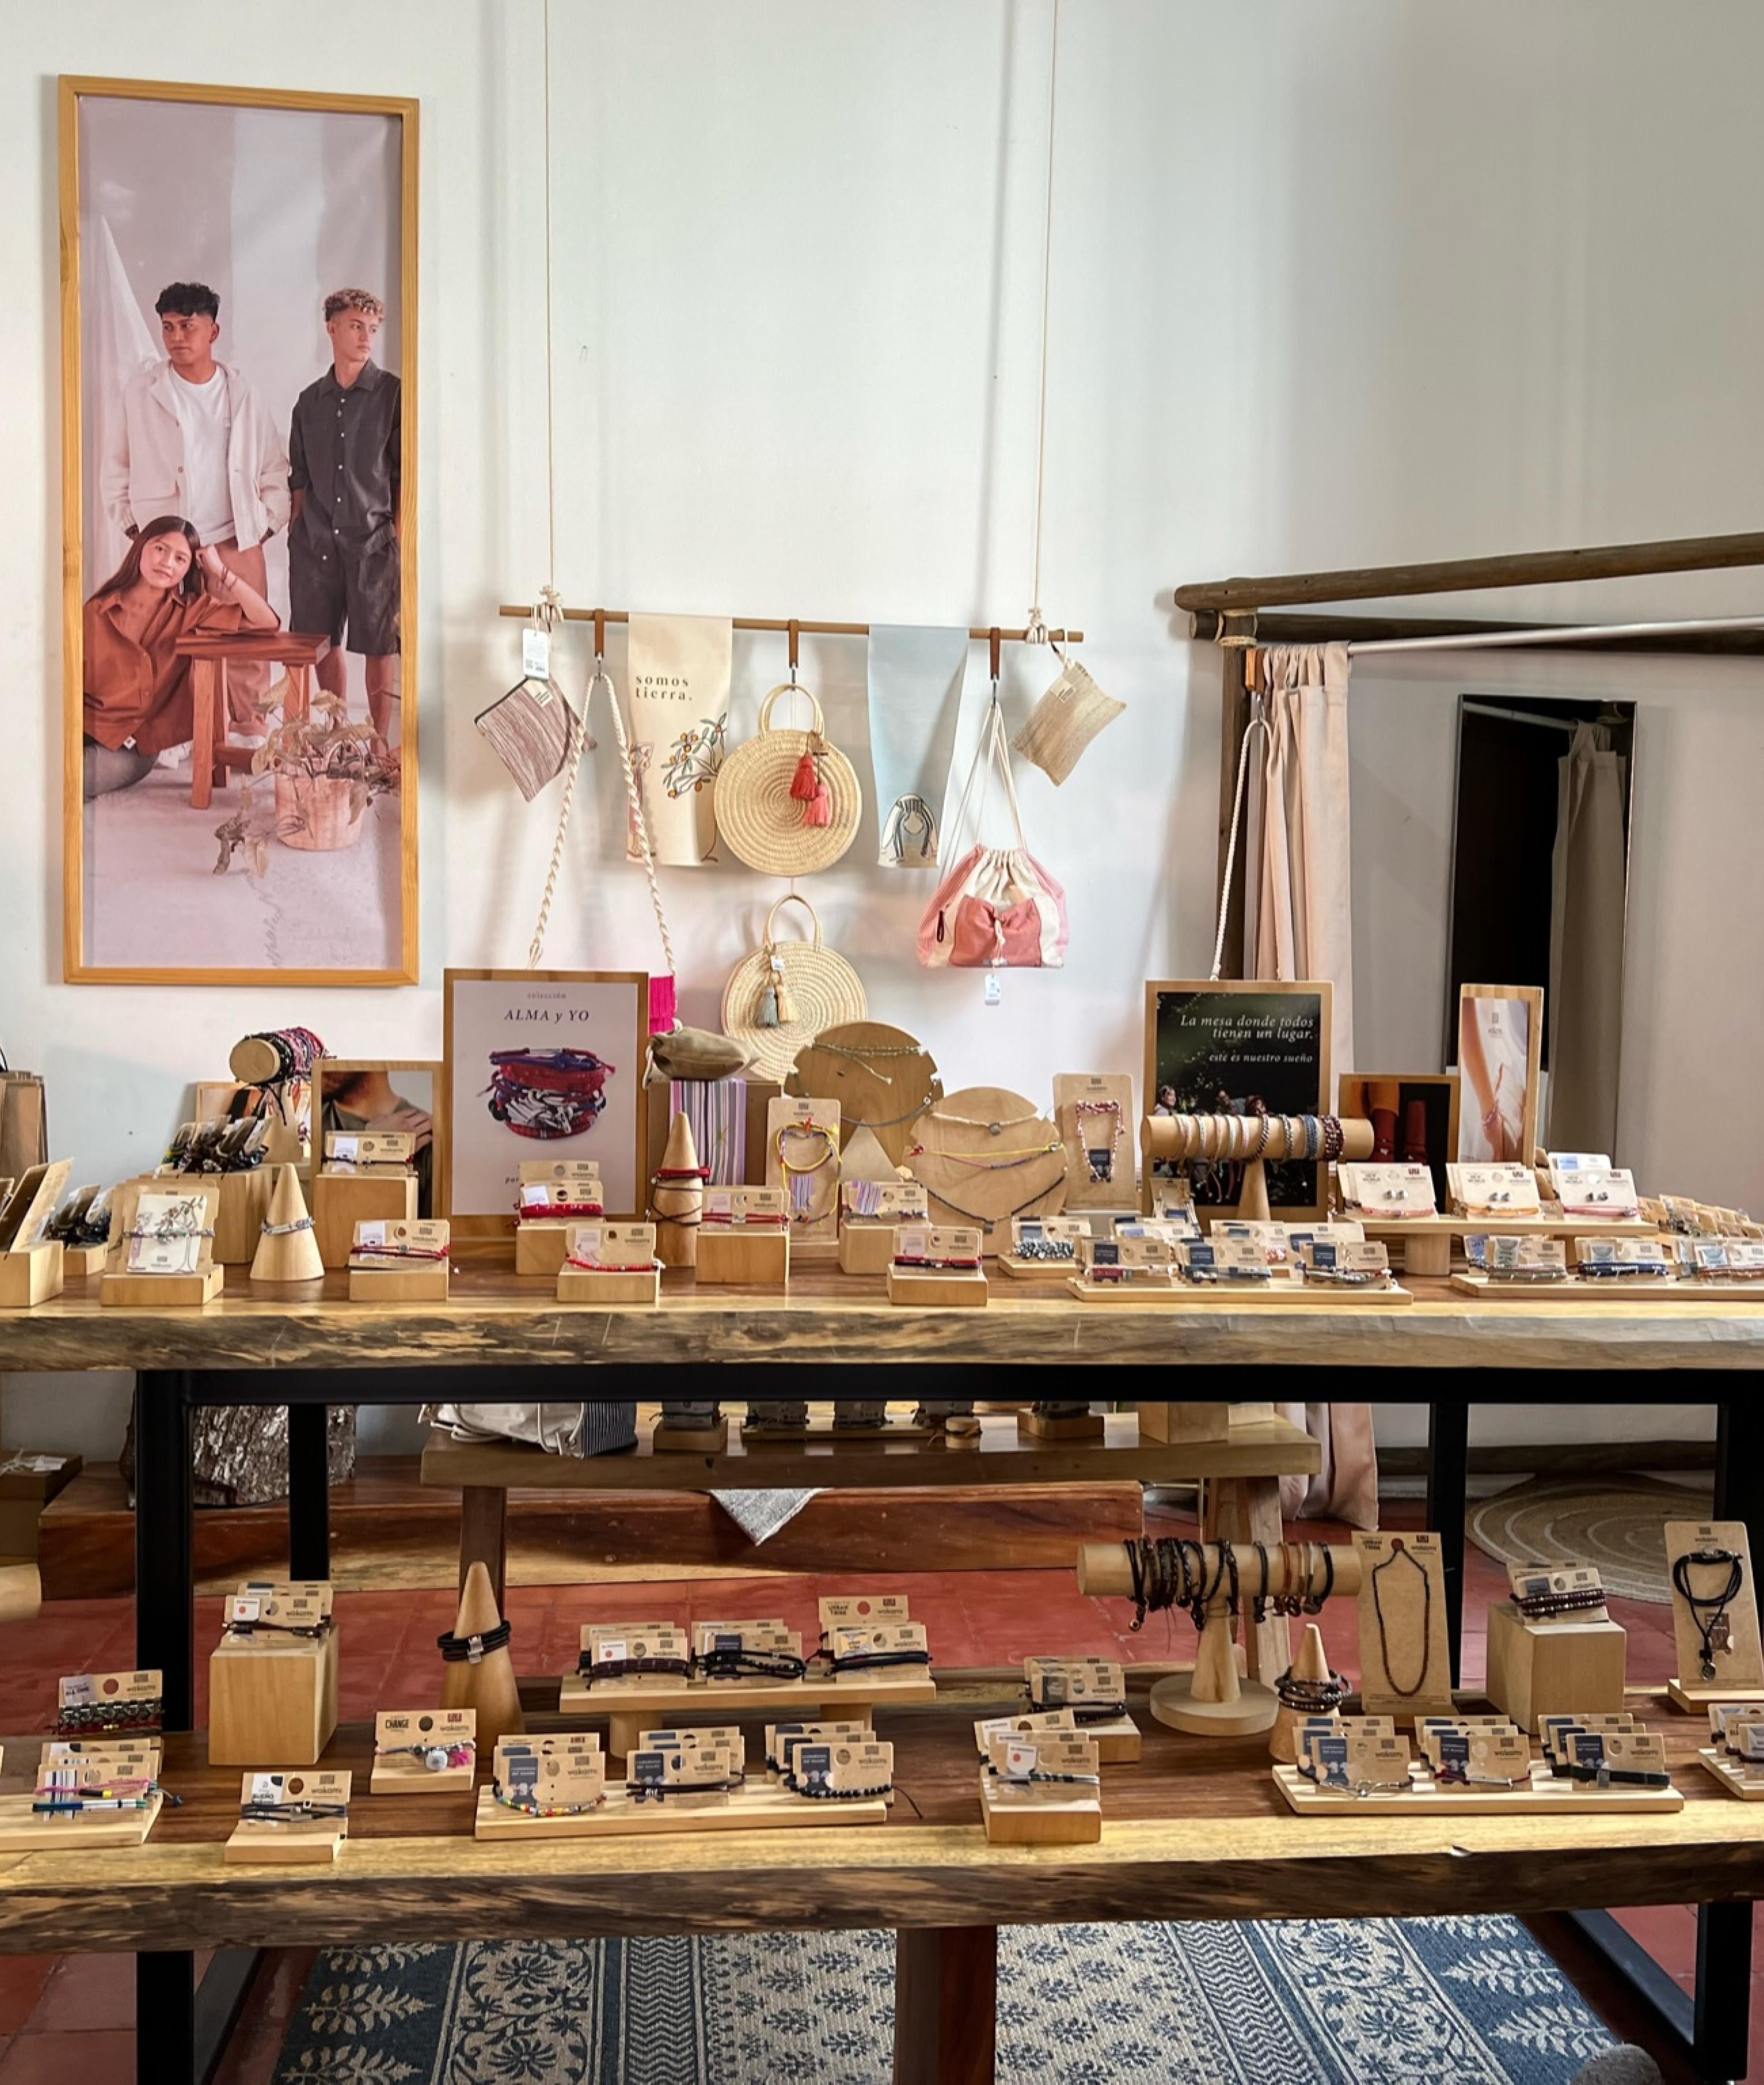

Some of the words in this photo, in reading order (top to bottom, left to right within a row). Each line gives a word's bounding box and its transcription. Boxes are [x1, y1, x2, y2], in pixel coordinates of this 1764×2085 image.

[635, 676, 688, 686] somos
[635, 686, 693, 701] tierra.
[504, 1009, 549, 1021] ALMA
[554, 1012, 563, 1025] y
[569, 1009, 589, 1022] YO
[1180, 1014, 1197, 1027] La
[1201, 1017, 1232, 1027] mesa
[1236, 1014, 1276, 1027] donde
[1279, 1014, 1314, 1028] todos
[1213, 1028, 1251, 1039] tienen
[1256, 1030, 1272, 1039] un
[1277, 1027, 1314, 1043] lugar.
[1209, 1052, 1228, 1062] este
[1231, 1054, 1240, 1062] es
[1243, 1054, 1281, 1063] nuestro
[1283, 1053, 1313, 1063] sueño
[384, 1718, 410, 1729] CHANGE
